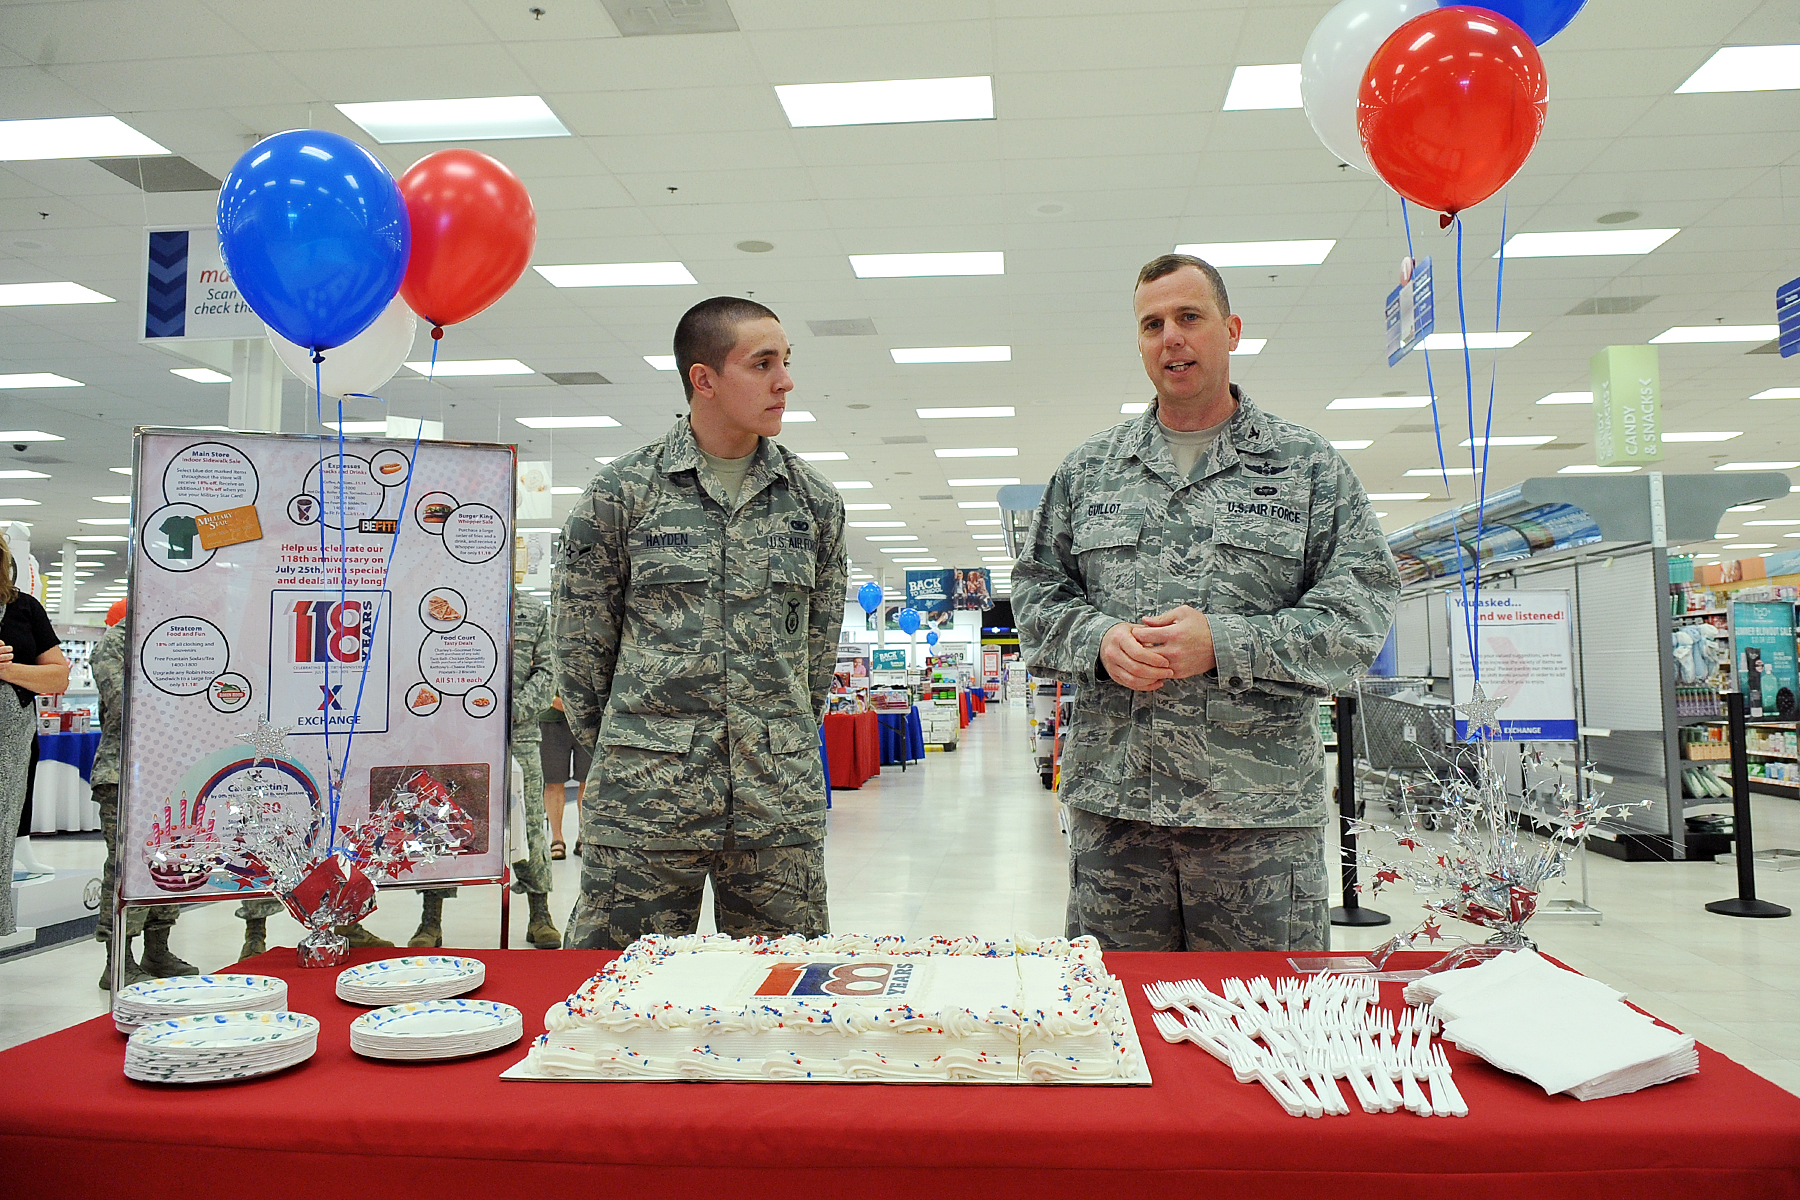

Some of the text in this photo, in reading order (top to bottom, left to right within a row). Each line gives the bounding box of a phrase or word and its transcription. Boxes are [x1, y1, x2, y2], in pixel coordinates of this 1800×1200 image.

[207, 288, 237, 300] Scan
[194, 302, 230, 315] check
[1641, 387, 1657, 455] & SNACKS
[1623, 405, 1639, 455] CANDY
[197, 512, 233, 526] MILITARY
[1228, 502, 1301, 523] U.S. AIR FORCE
[209, 520, 228, 530] STAR
[645, 533, 689, 547] HAYDEN
[770, 536, 787, 548] U.S.
[789, 537, 803, 550] AIR
[281, 544, 304, 553] Help
[312, 555, 370, 565] anniversary
[371, 556, 384, 564] on
[275, 565, 296, 575] July
[298, 566, 324, 574] 25th,
[349, 567, 388, 575] specials
[908, 578, 942, 591] BACK
[920, 587, 944, 595] SCHOOL
[1473, 612, 1494, 621] nd
[1515, 611, 1565, 621] listened!
[292, 600, 362, 663] 118
[362, 600, 373, 663] YEARS
[1780, 626, 1792, 636] SALE
[298, 716, 361, 726] EXCHANGE
[754, 962, 894, 996] 118
[886, 963, 914, 996] YEARS
